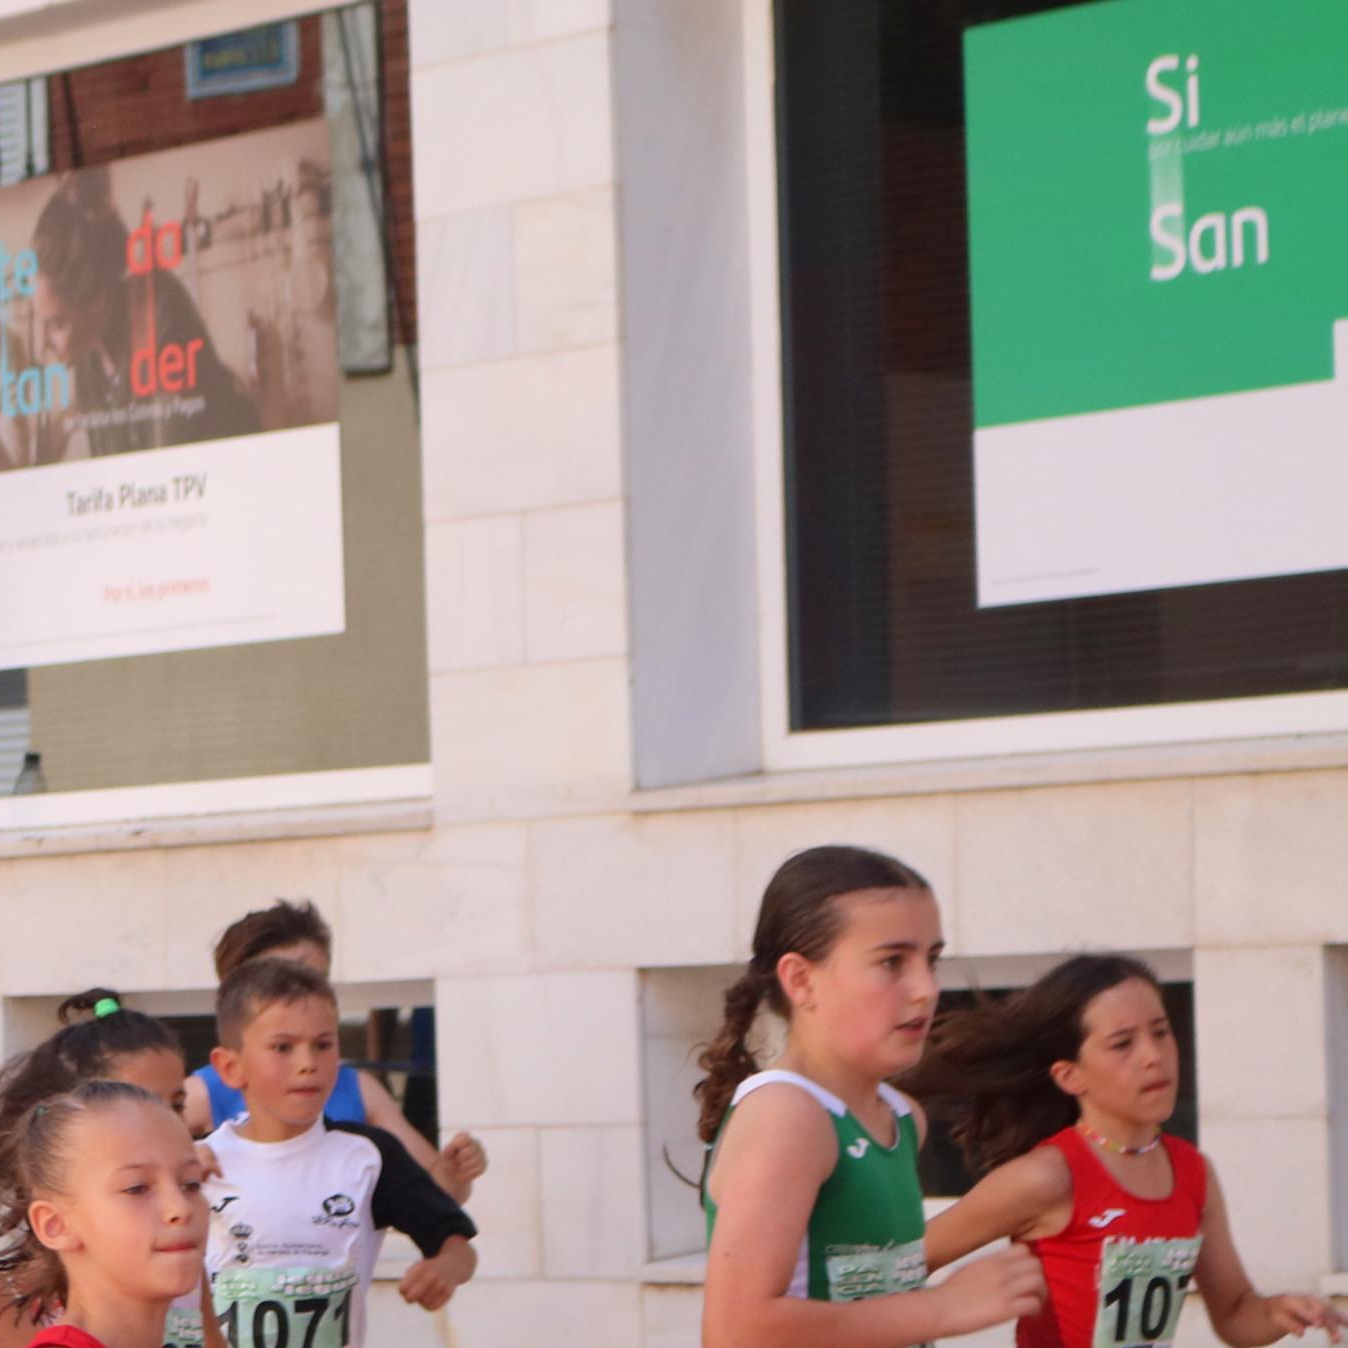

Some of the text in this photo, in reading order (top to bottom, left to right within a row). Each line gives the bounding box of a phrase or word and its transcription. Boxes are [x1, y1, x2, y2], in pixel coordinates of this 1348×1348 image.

[1145, 54, 1200, 134] Si
[1150, 202, 1270, 281] San
[130, 338, 205, 396] der
[66, 473, 207, 517] Tarifa Plana TPV
